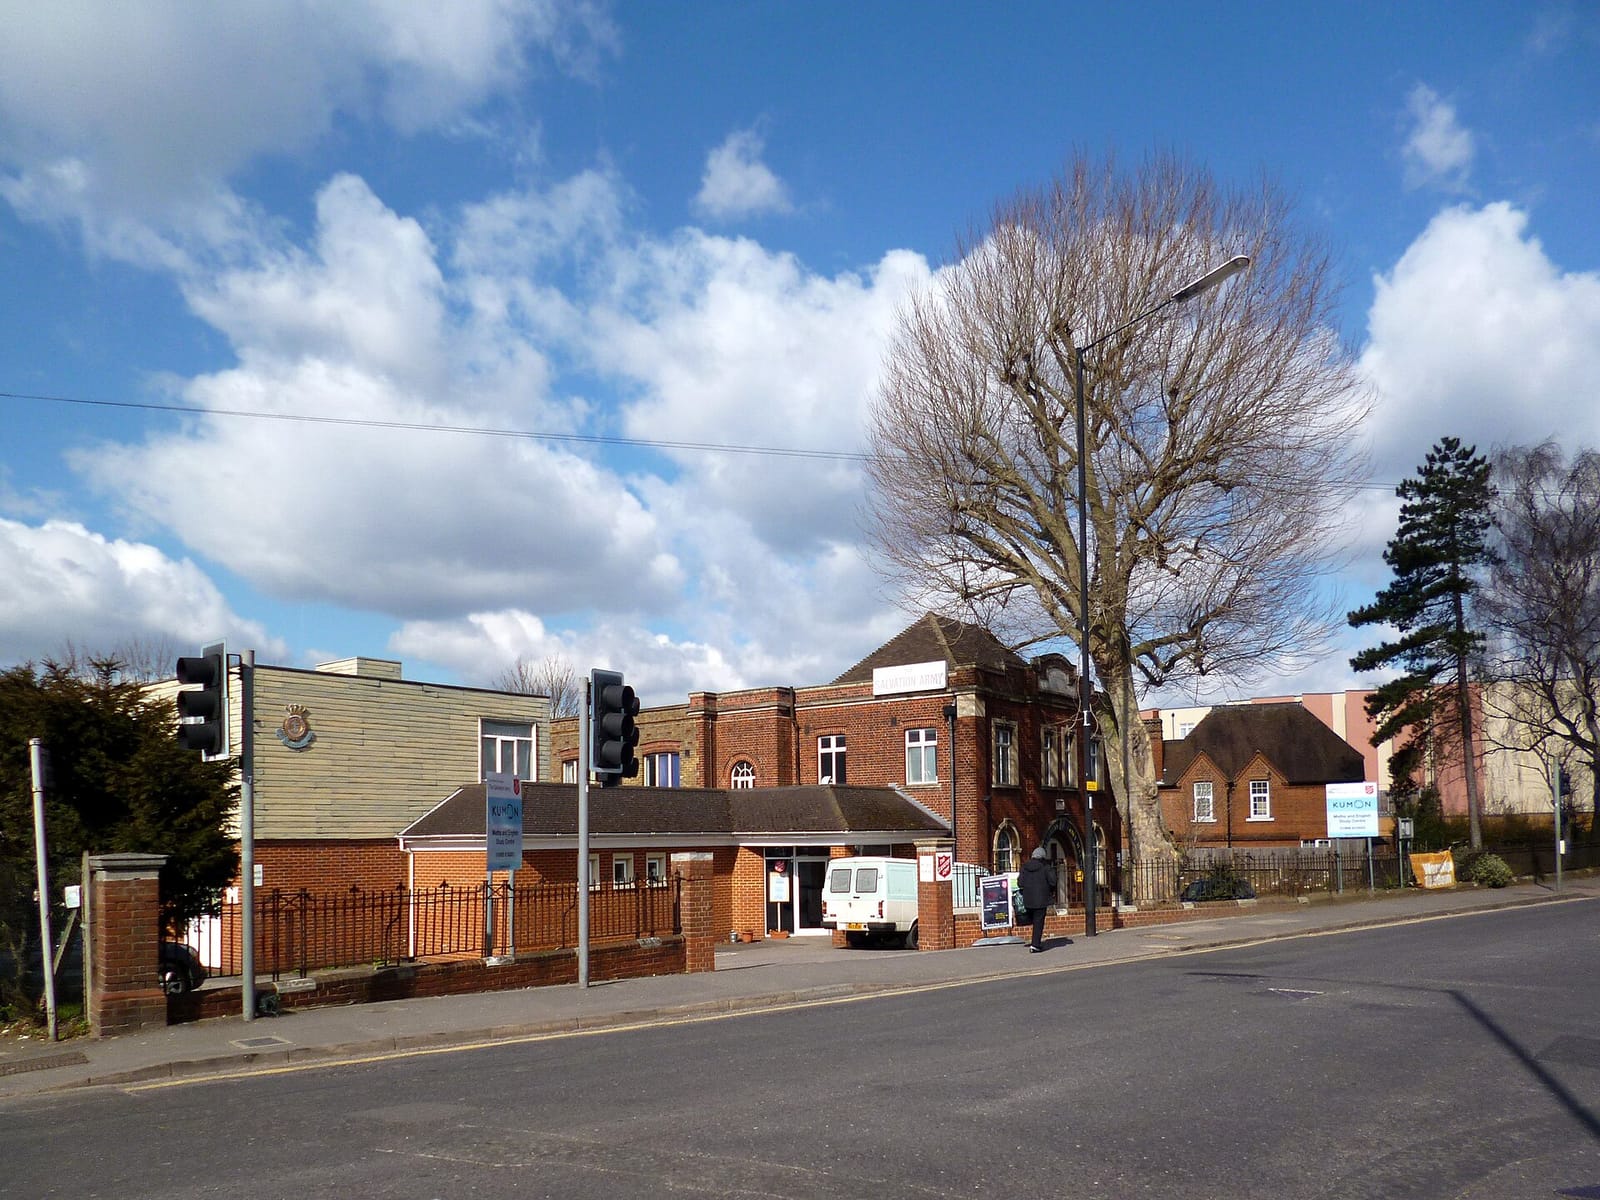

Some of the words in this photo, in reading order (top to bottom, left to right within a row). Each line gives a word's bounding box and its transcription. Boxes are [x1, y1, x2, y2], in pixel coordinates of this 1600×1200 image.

[875, 676, 916, 690] SALVATION
[920, 672, 944, 686] ARMY
[492, 804, 518, 819] KUMON
[1332, 800, 1371, 808] KUMON
